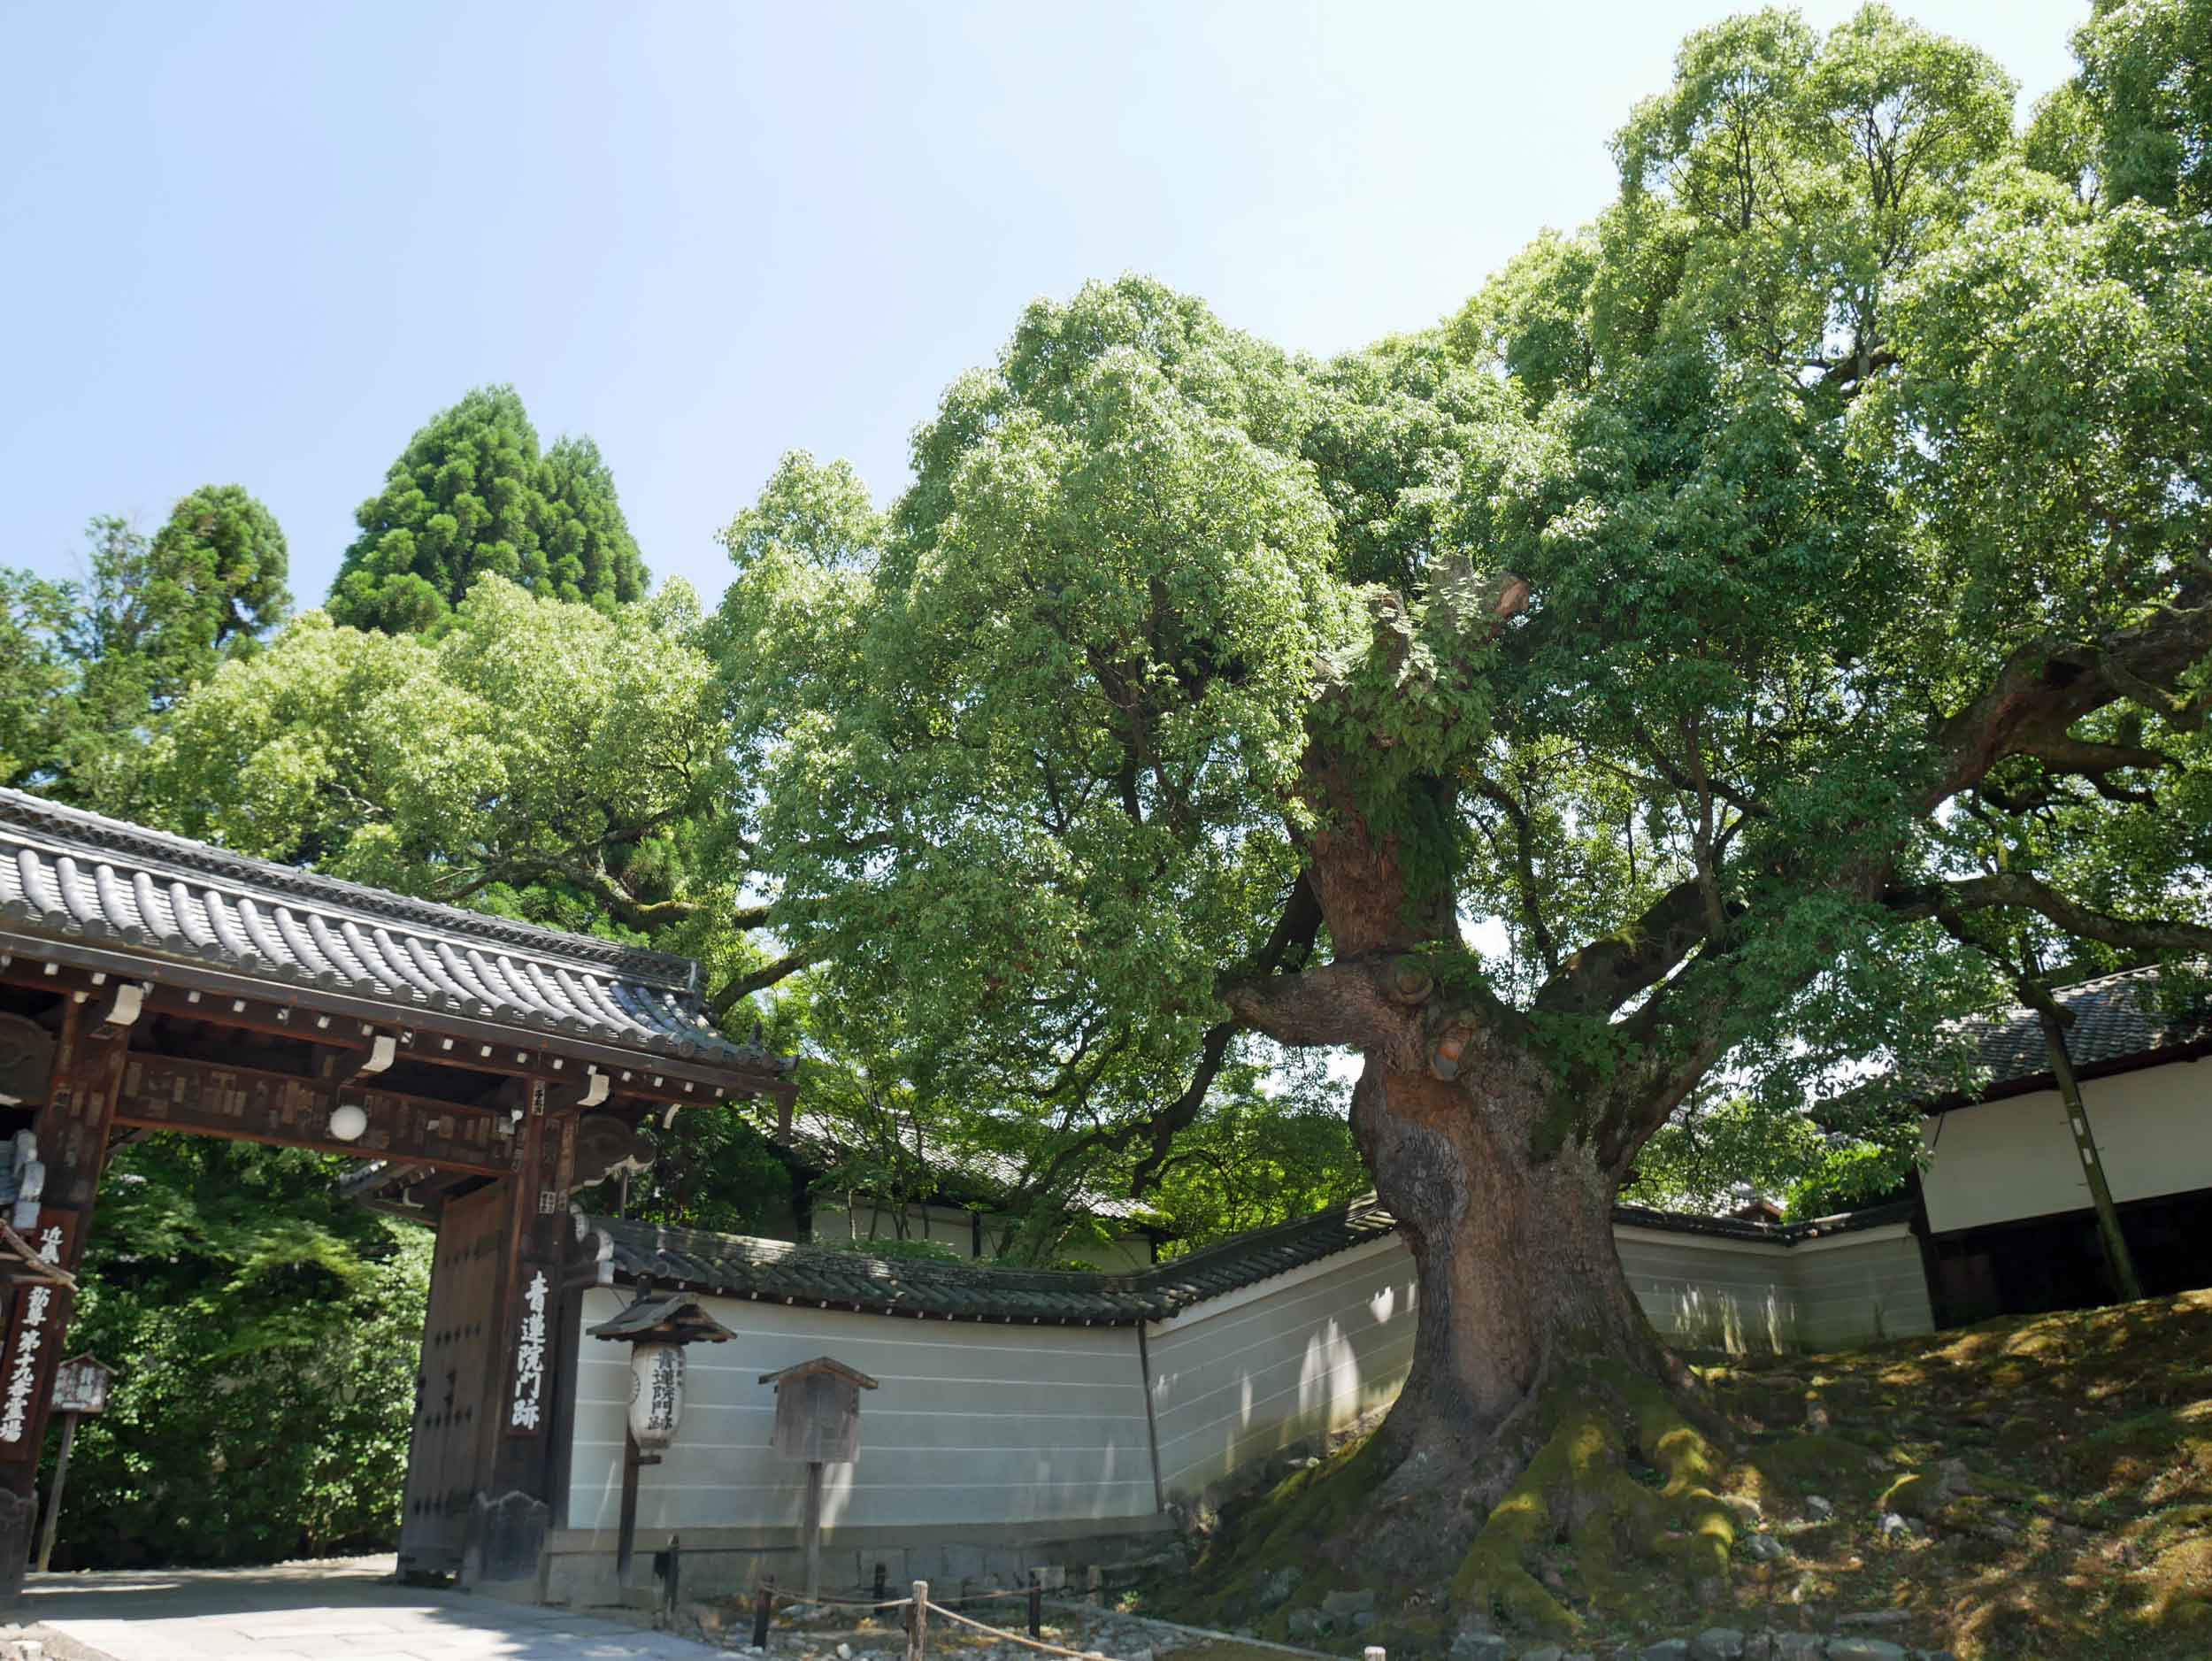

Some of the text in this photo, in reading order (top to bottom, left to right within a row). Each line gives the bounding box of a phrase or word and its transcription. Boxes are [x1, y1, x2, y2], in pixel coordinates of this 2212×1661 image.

[511, 1270, 549, 1430] 青蓮院門跡
[647, 1349, 676, 1431] 青蓮院門跡
